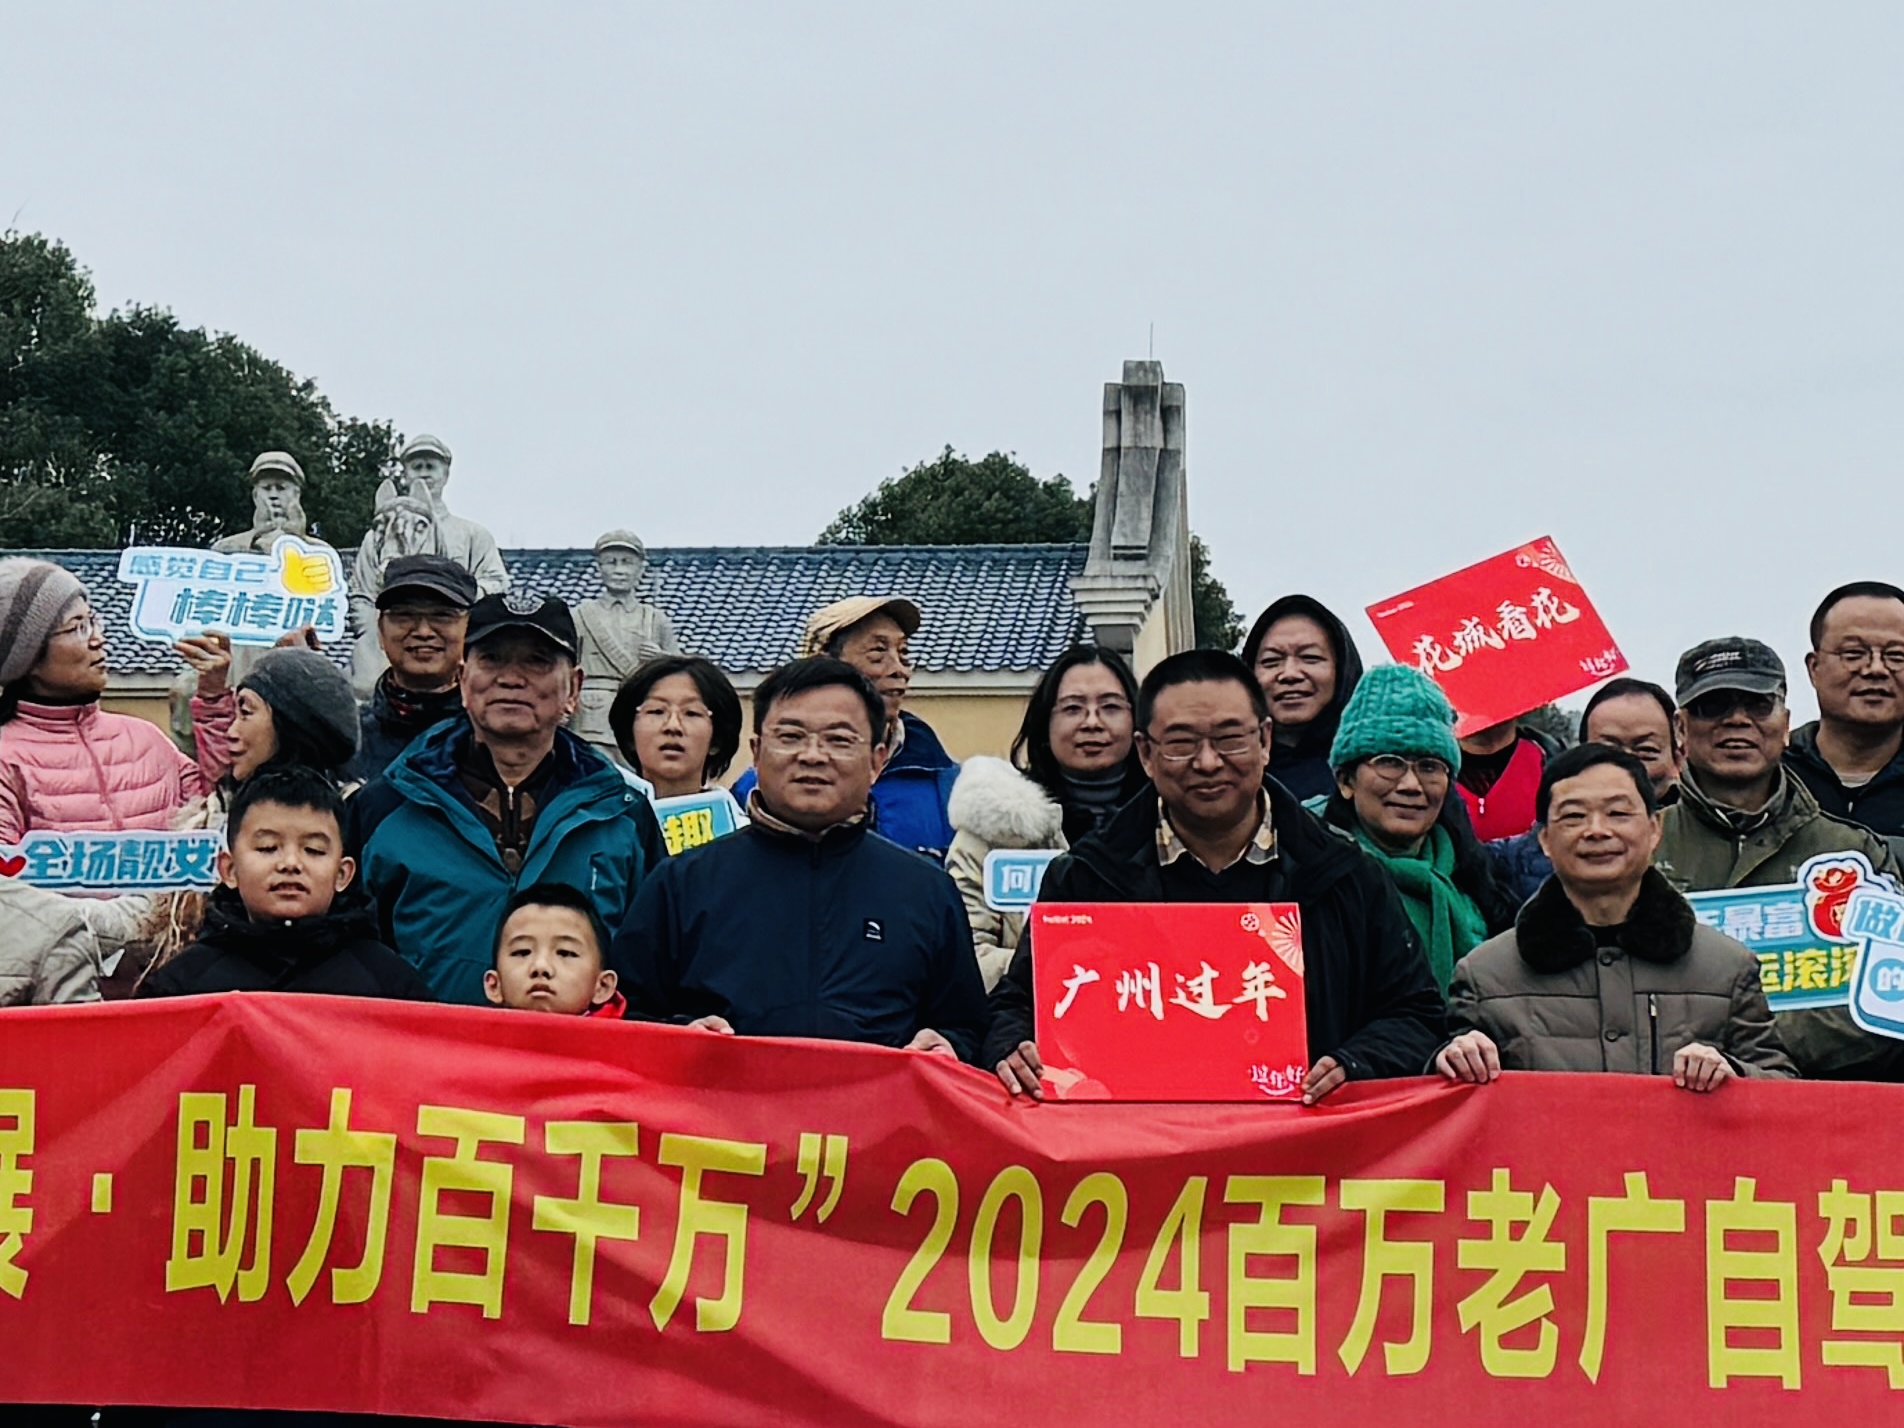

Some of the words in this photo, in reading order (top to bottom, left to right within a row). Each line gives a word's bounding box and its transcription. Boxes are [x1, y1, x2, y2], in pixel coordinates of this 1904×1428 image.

[130, 554, 267, 584] 感觉自己
[170, 587, 338, 629] 棒棒哒
[22, 838, 220, 880] 全场靓女
[1053, 960, 1287, 1022] 广州过年
